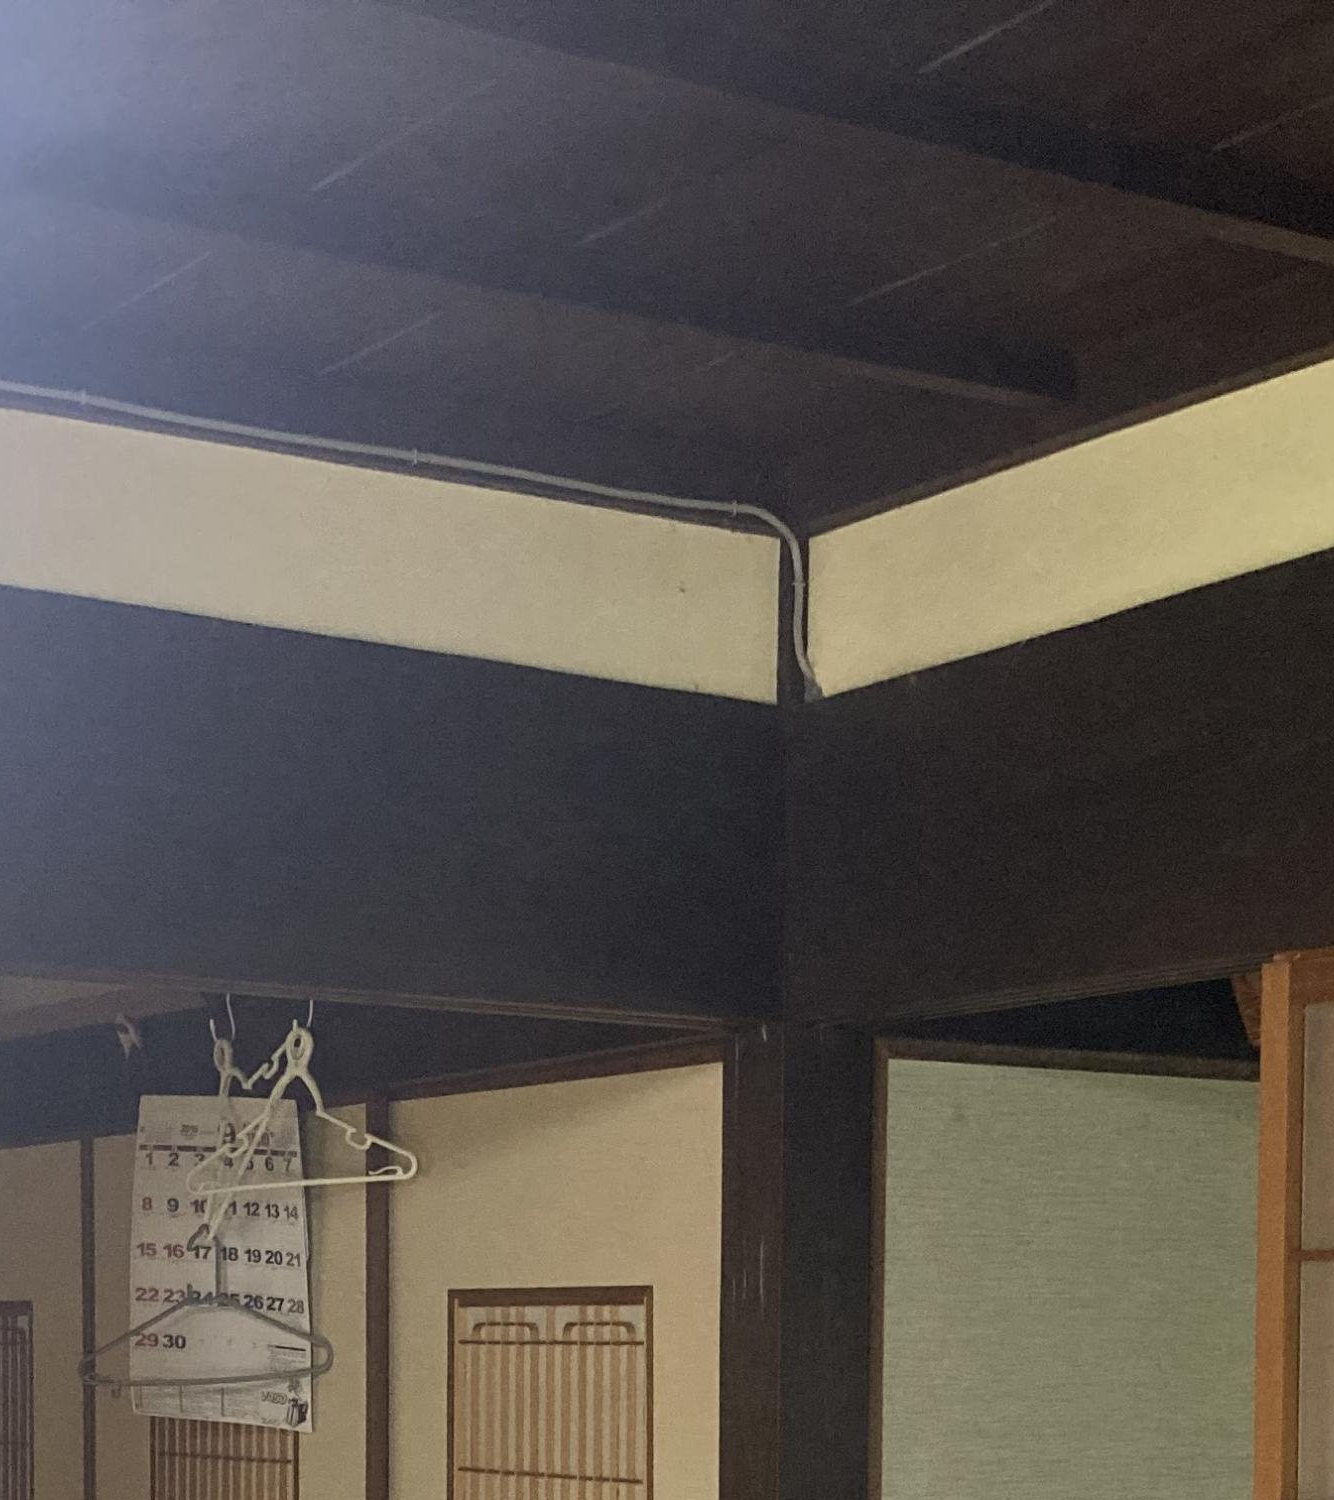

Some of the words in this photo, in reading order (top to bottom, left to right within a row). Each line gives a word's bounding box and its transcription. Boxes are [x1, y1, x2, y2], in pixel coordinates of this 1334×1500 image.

[145, 1152, 154, 1166] 1
[168, 1152, 180, 1167] 2
[264, 1156, 275, 1172] 6
[283, 1157, 293, 1173] 7
[141, 1196, 153, 1212] 8
[167, 1197, 180, 1213] 9
[243, 1201, 260, 1217] 12
[264, 1203, 280, 1218] 13
[283, 1204, 299, 1220] 14
[137, 1242, 157, 1257] 15
[163, 1243, 185, 1259] 16
[192, 1245, 212, 1260] 17
[220, 1246, 239, 1261] 18
[244, 1248, 262, 1263] 19
[265, 1250, 283, 1265] 20
[285, 1251, 301, 1267] 21
[135, 1287, 159, 1302] 22
[163, 1288, 186, 1304] 23
[243, 1294, 264, 1310] 26
[266, 1296, 285, 1312] 27
[287, 1298, 305, 1314] 28
[135, 1333, 159, 1347] 29
[162, 1334, 186, 1350] 30
